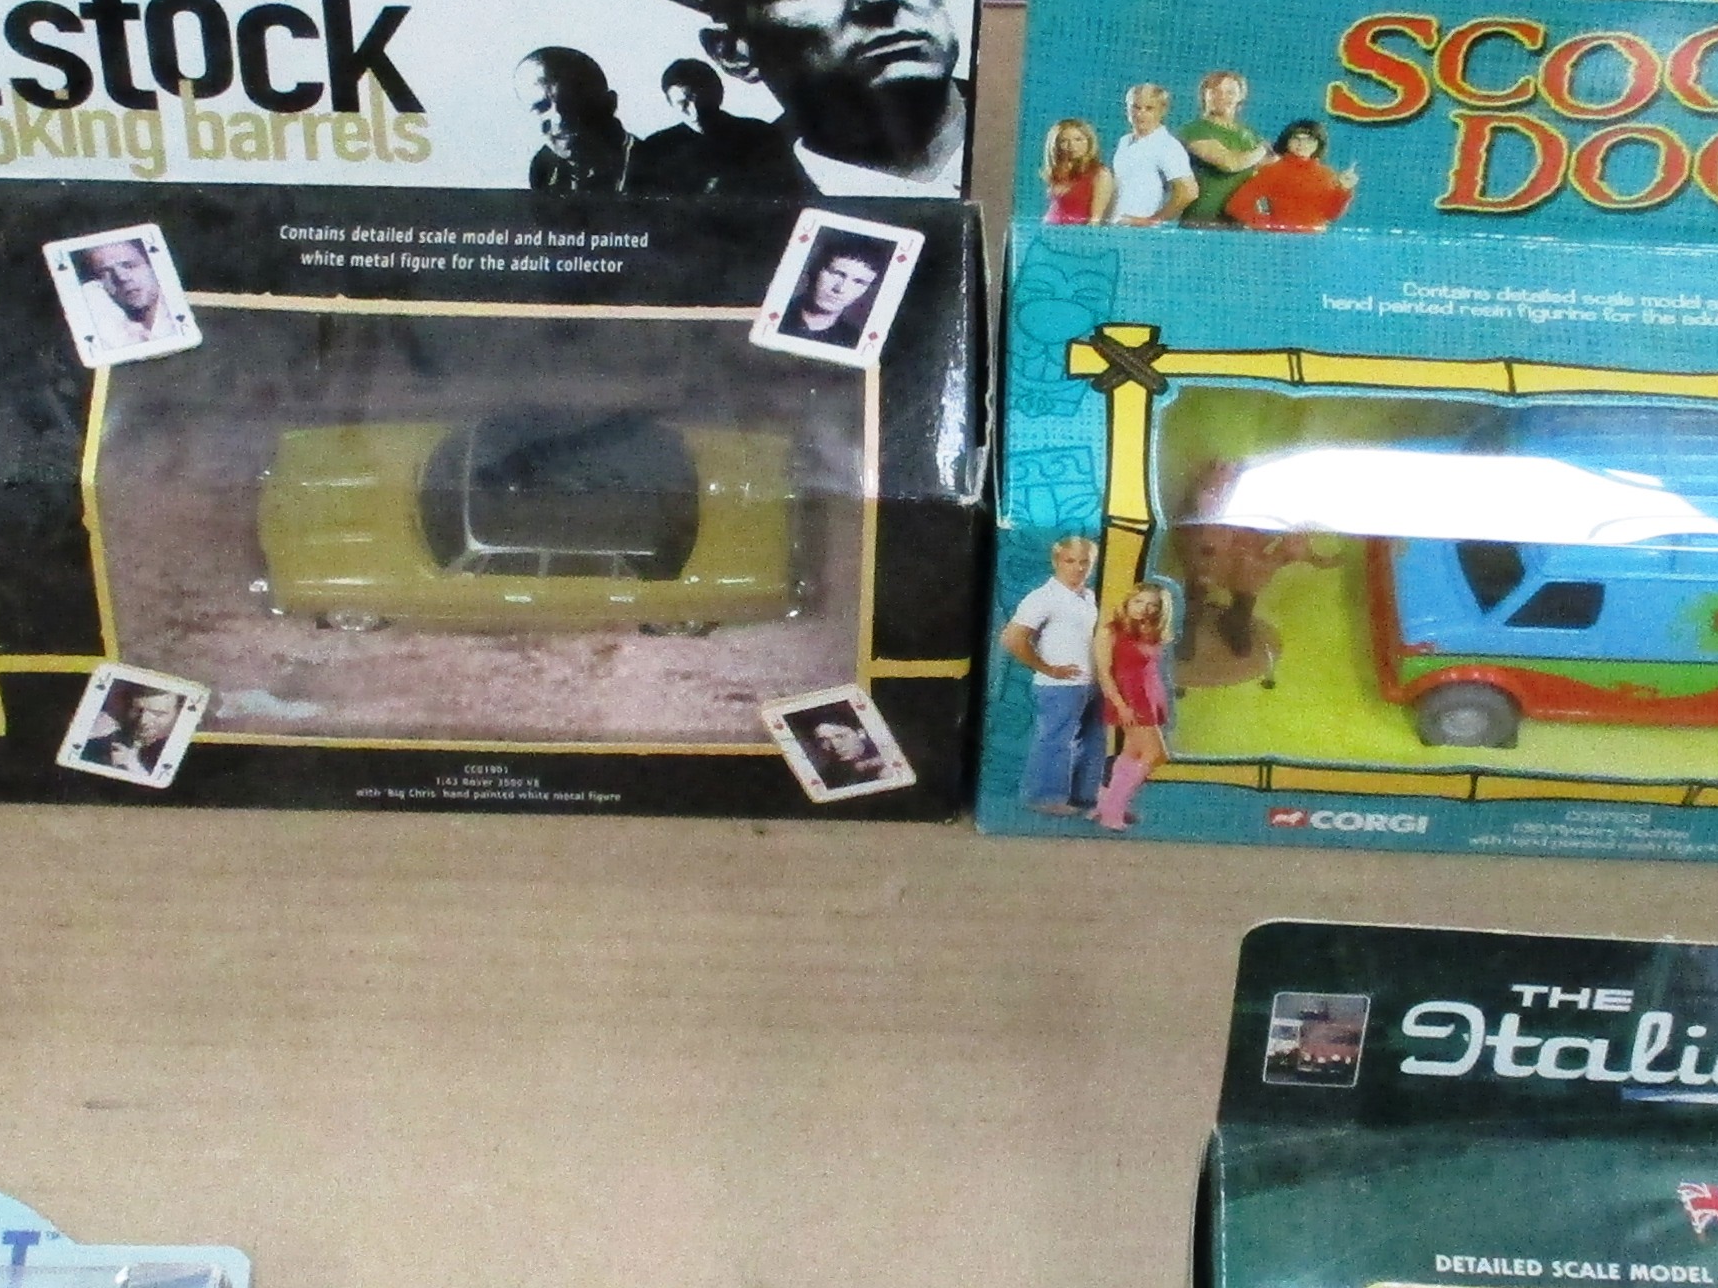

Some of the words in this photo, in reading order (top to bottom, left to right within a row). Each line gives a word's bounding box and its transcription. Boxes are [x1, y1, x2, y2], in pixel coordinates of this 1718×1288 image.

[181, 77, 432, 163] barrels
[279, 223, 346, 244] Contains
[351, 224, 413, 246] detailed
[418, 227, 457, 247] scale
[461, 228, 510, 248] model
[514, 229, 542, 248] and
[546, 229, 586, 249] hand
[590, 231, 649, 255] painted
[300, 249, 347, 269] white
[351, 250, 394, 270] metal
[399, 250, 447, 277] figure
[451, 252, 474, 271] for
[479, 253, 506, 272] the
[510, 255, 549, 274] adult
[554, 255, 624, 275] collector
[1322, 293, 1373, 310] hand
[1379, 297, 1454, 317] painted
[1603, 307, 1636, 323] for
[1643, 308, 1676, 325] the
[1403, 281, 1490, 302] Contains
[1497, 286, 1576, 306] detailed
[1582, 291, 1635, 309] scale
[1641, 294, 1702, 310] model
[473, 789, 515, 802] painted
[518, 790, 550, 801] white
[1309, 808, 1429, 836] CORGI
[1511, 983, 1635, 1013] THE
[1435, 1254, 1543, 1279] DETAILED
[1551, 1258, 1621, 1282] SCALE
[1629, 1261, 1713, 1286] MODEL
